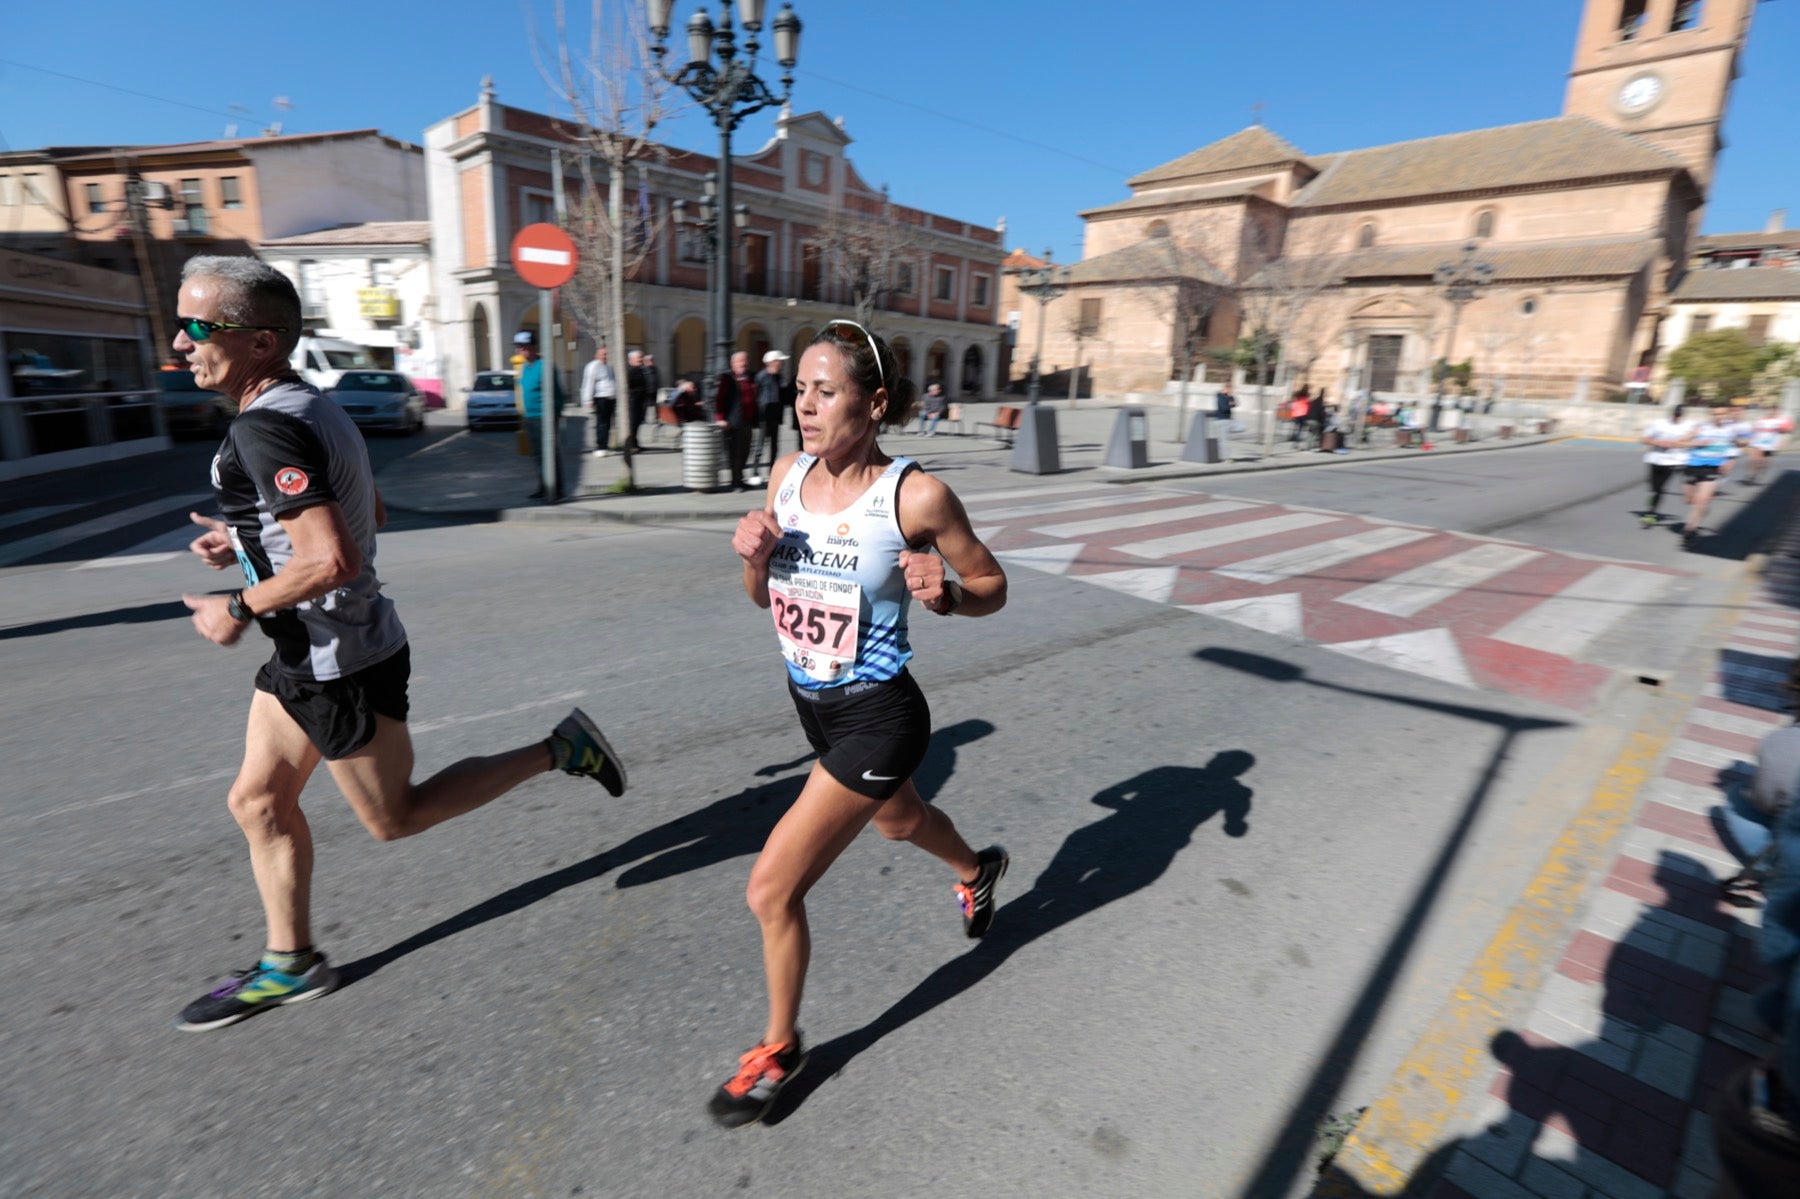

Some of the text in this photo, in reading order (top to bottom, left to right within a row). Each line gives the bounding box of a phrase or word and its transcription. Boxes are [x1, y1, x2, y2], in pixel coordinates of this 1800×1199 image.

[773, 545, 859, 571] ARACENA
[795, 578, 817, 589] PREMIO
[819, 581, 828, 591] DE
[775, 597, 852, 649] 2257
